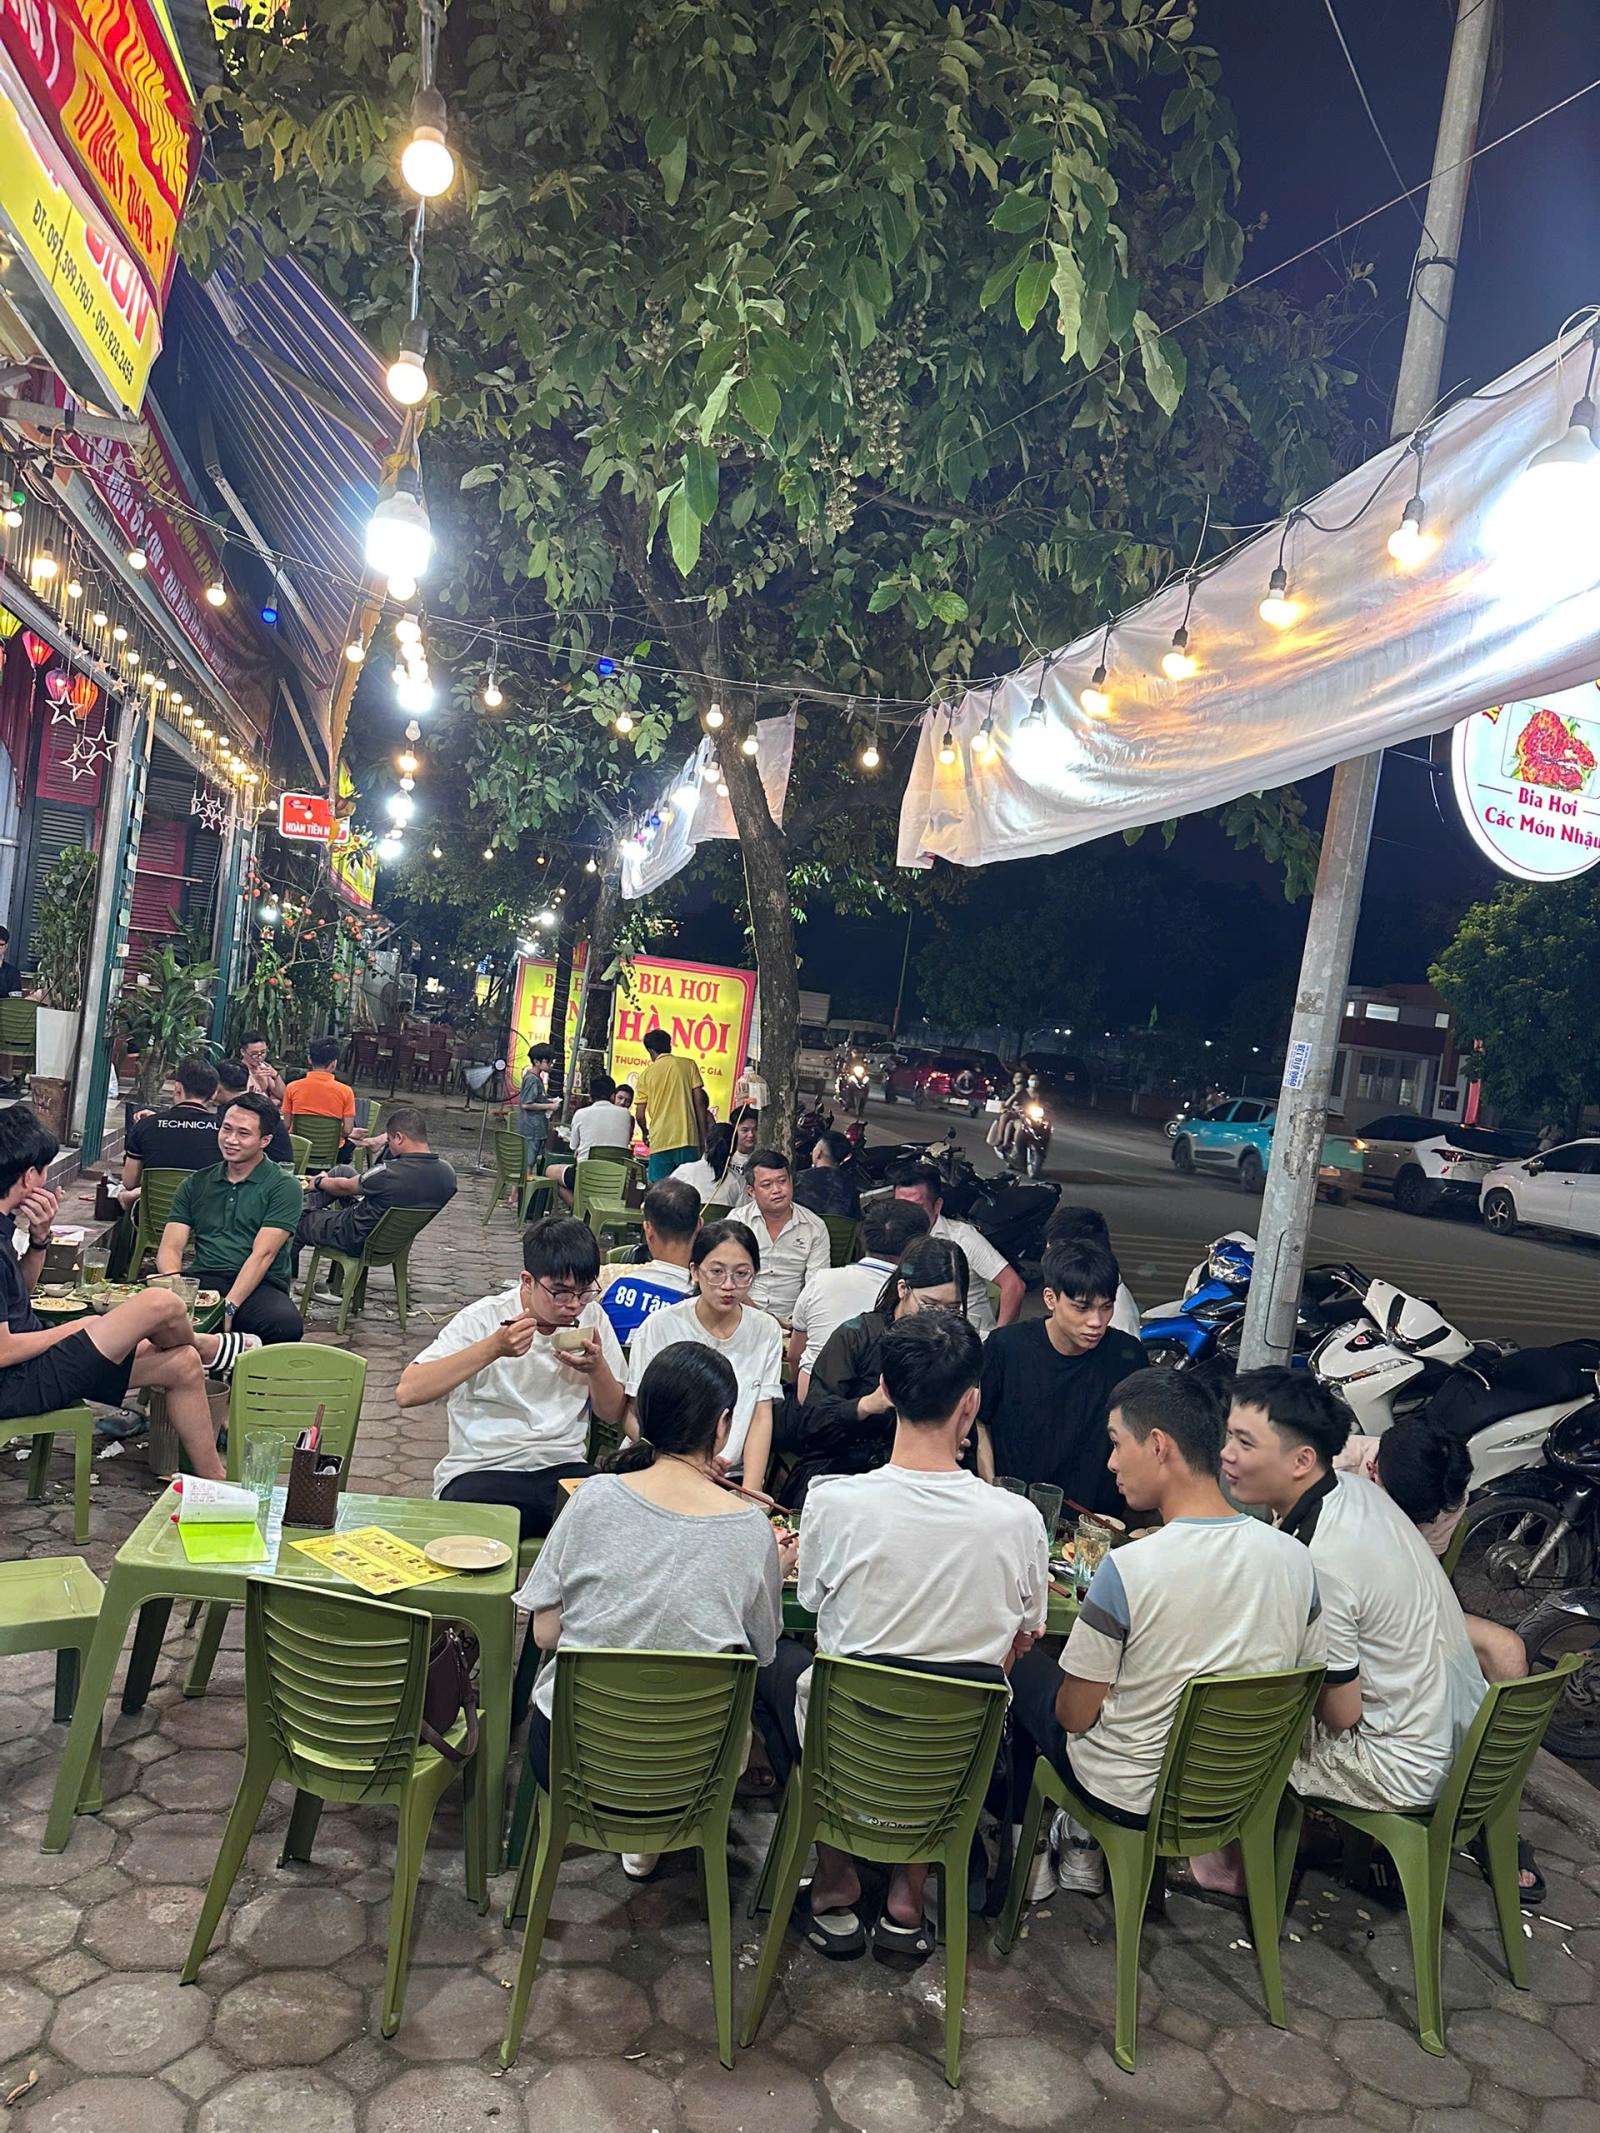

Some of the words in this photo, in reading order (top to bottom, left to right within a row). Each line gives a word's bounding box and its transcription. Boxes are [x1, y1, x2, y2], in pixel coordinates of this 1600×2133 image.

[1518, 787, 1543, 808] Bia
[1548, 794, 1578, 816] Hơi
[1485, 806, 1515, 828] Các
[1520, 814, 1555, 838] Món
[1560, 824, 1600, 850] Nhậu
[638, 972, 674, 997] BIA
[679, 978, 720, 1004] HƠI
[615, 1004, 661, 1043] HÀ
[671, 1013, 731, 1060] NỘI
[707, 1066, 723, 1076] GIA
[158, 1119, 219, 1130] TECHNICAL
[615, 1285, 638, 1308] 89
